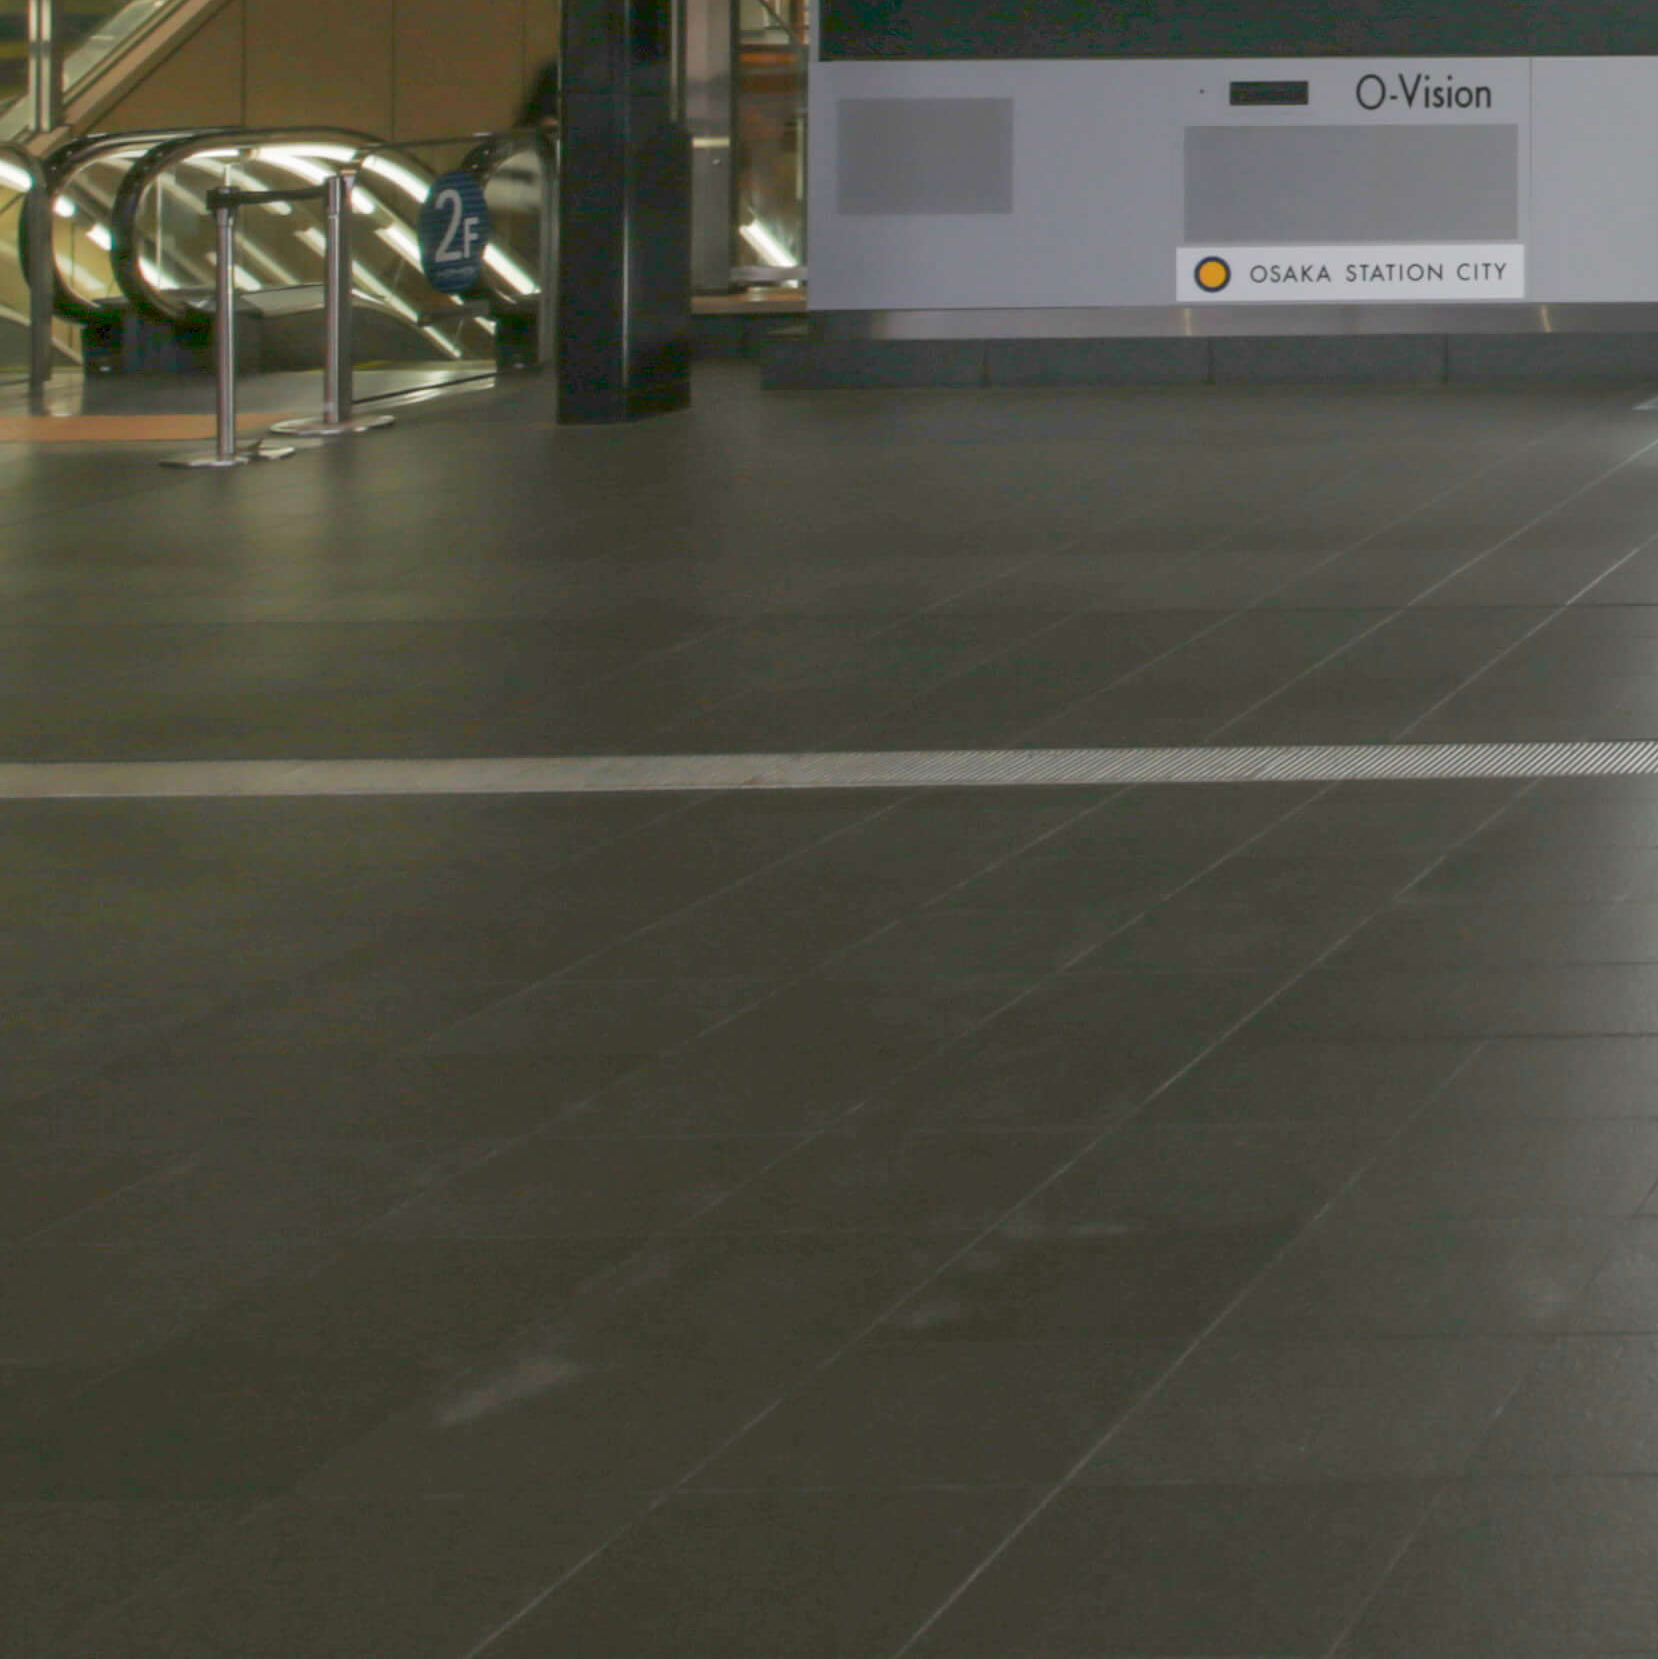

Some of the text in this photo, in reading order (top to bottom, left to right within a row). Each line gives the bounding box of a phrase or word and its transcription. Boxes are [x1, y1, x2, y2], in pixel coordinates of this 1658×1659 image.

[1355, 73, 1492, 110] O-Vision
[435, 189, 480, 263] 2F
[1249, 262, 1507, 284] OSAKA STATION CITY
